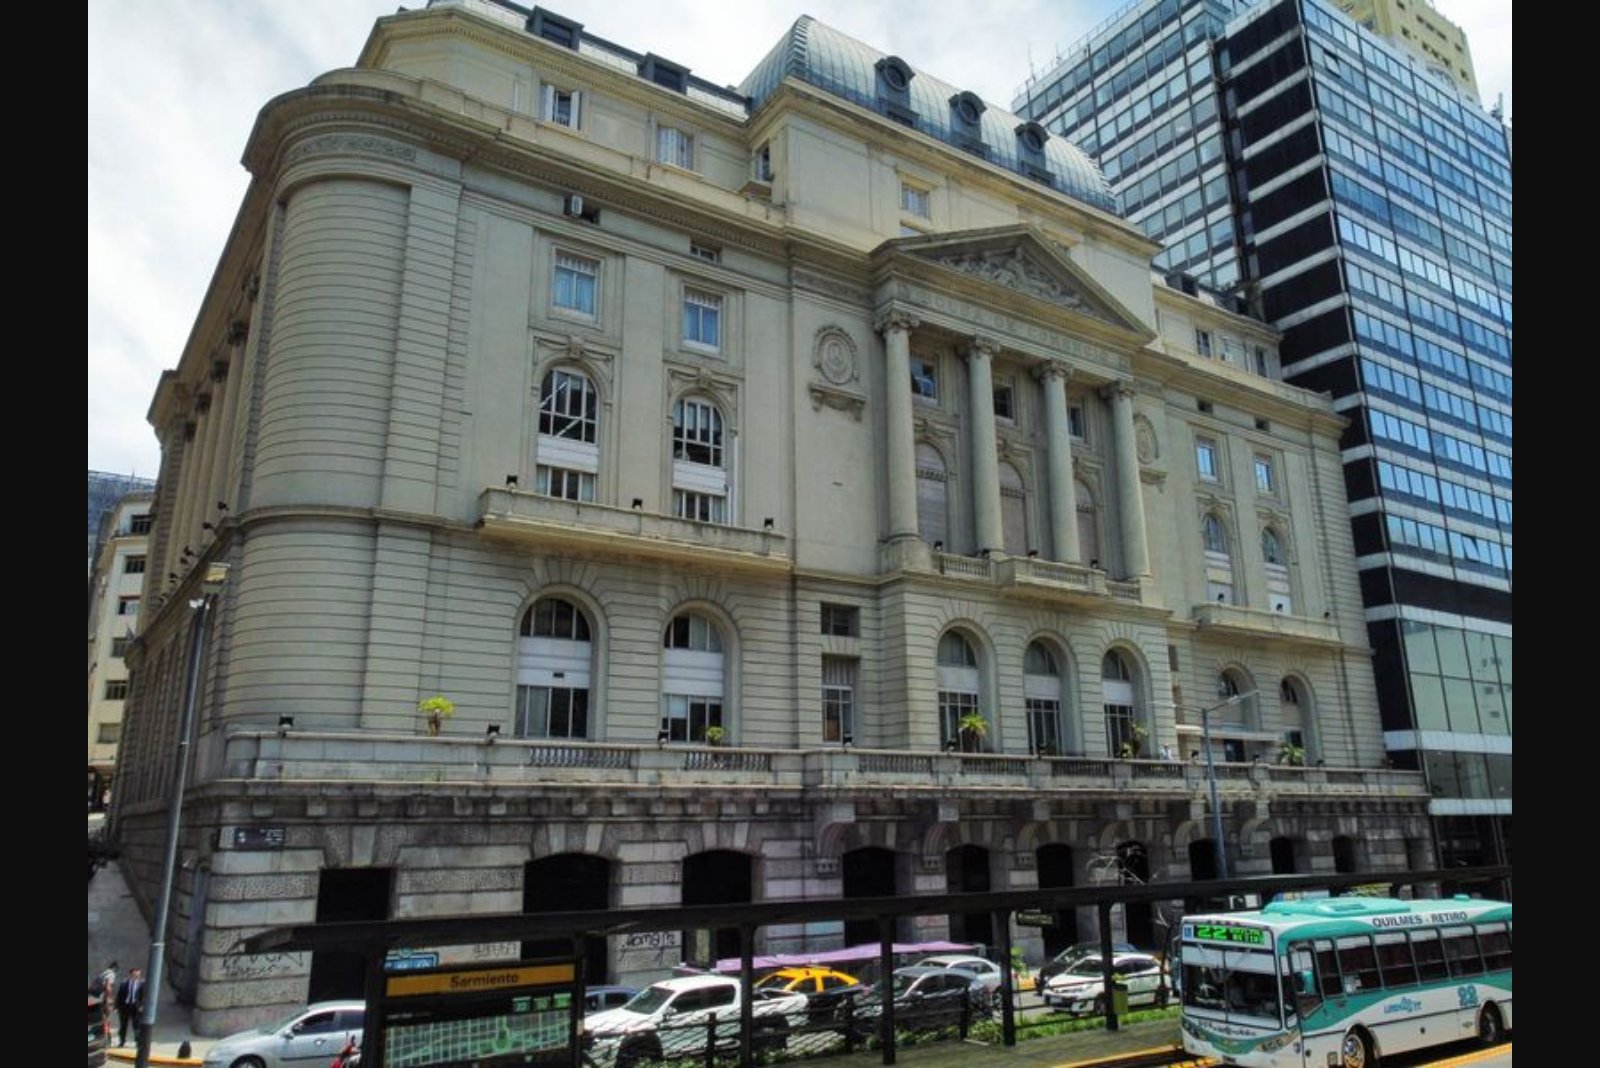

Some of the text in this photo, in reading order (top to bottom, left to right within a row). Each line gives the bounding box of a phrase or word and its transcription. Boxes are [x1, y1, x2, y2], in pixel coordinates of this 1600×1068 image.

[1373, 914, 1422, 927] QUILMES
[1431, 911, 1468, 922] RETIRO
[1197, 924, 1228, 940] 22
[451, 973, 519, 988] Sarmiento
